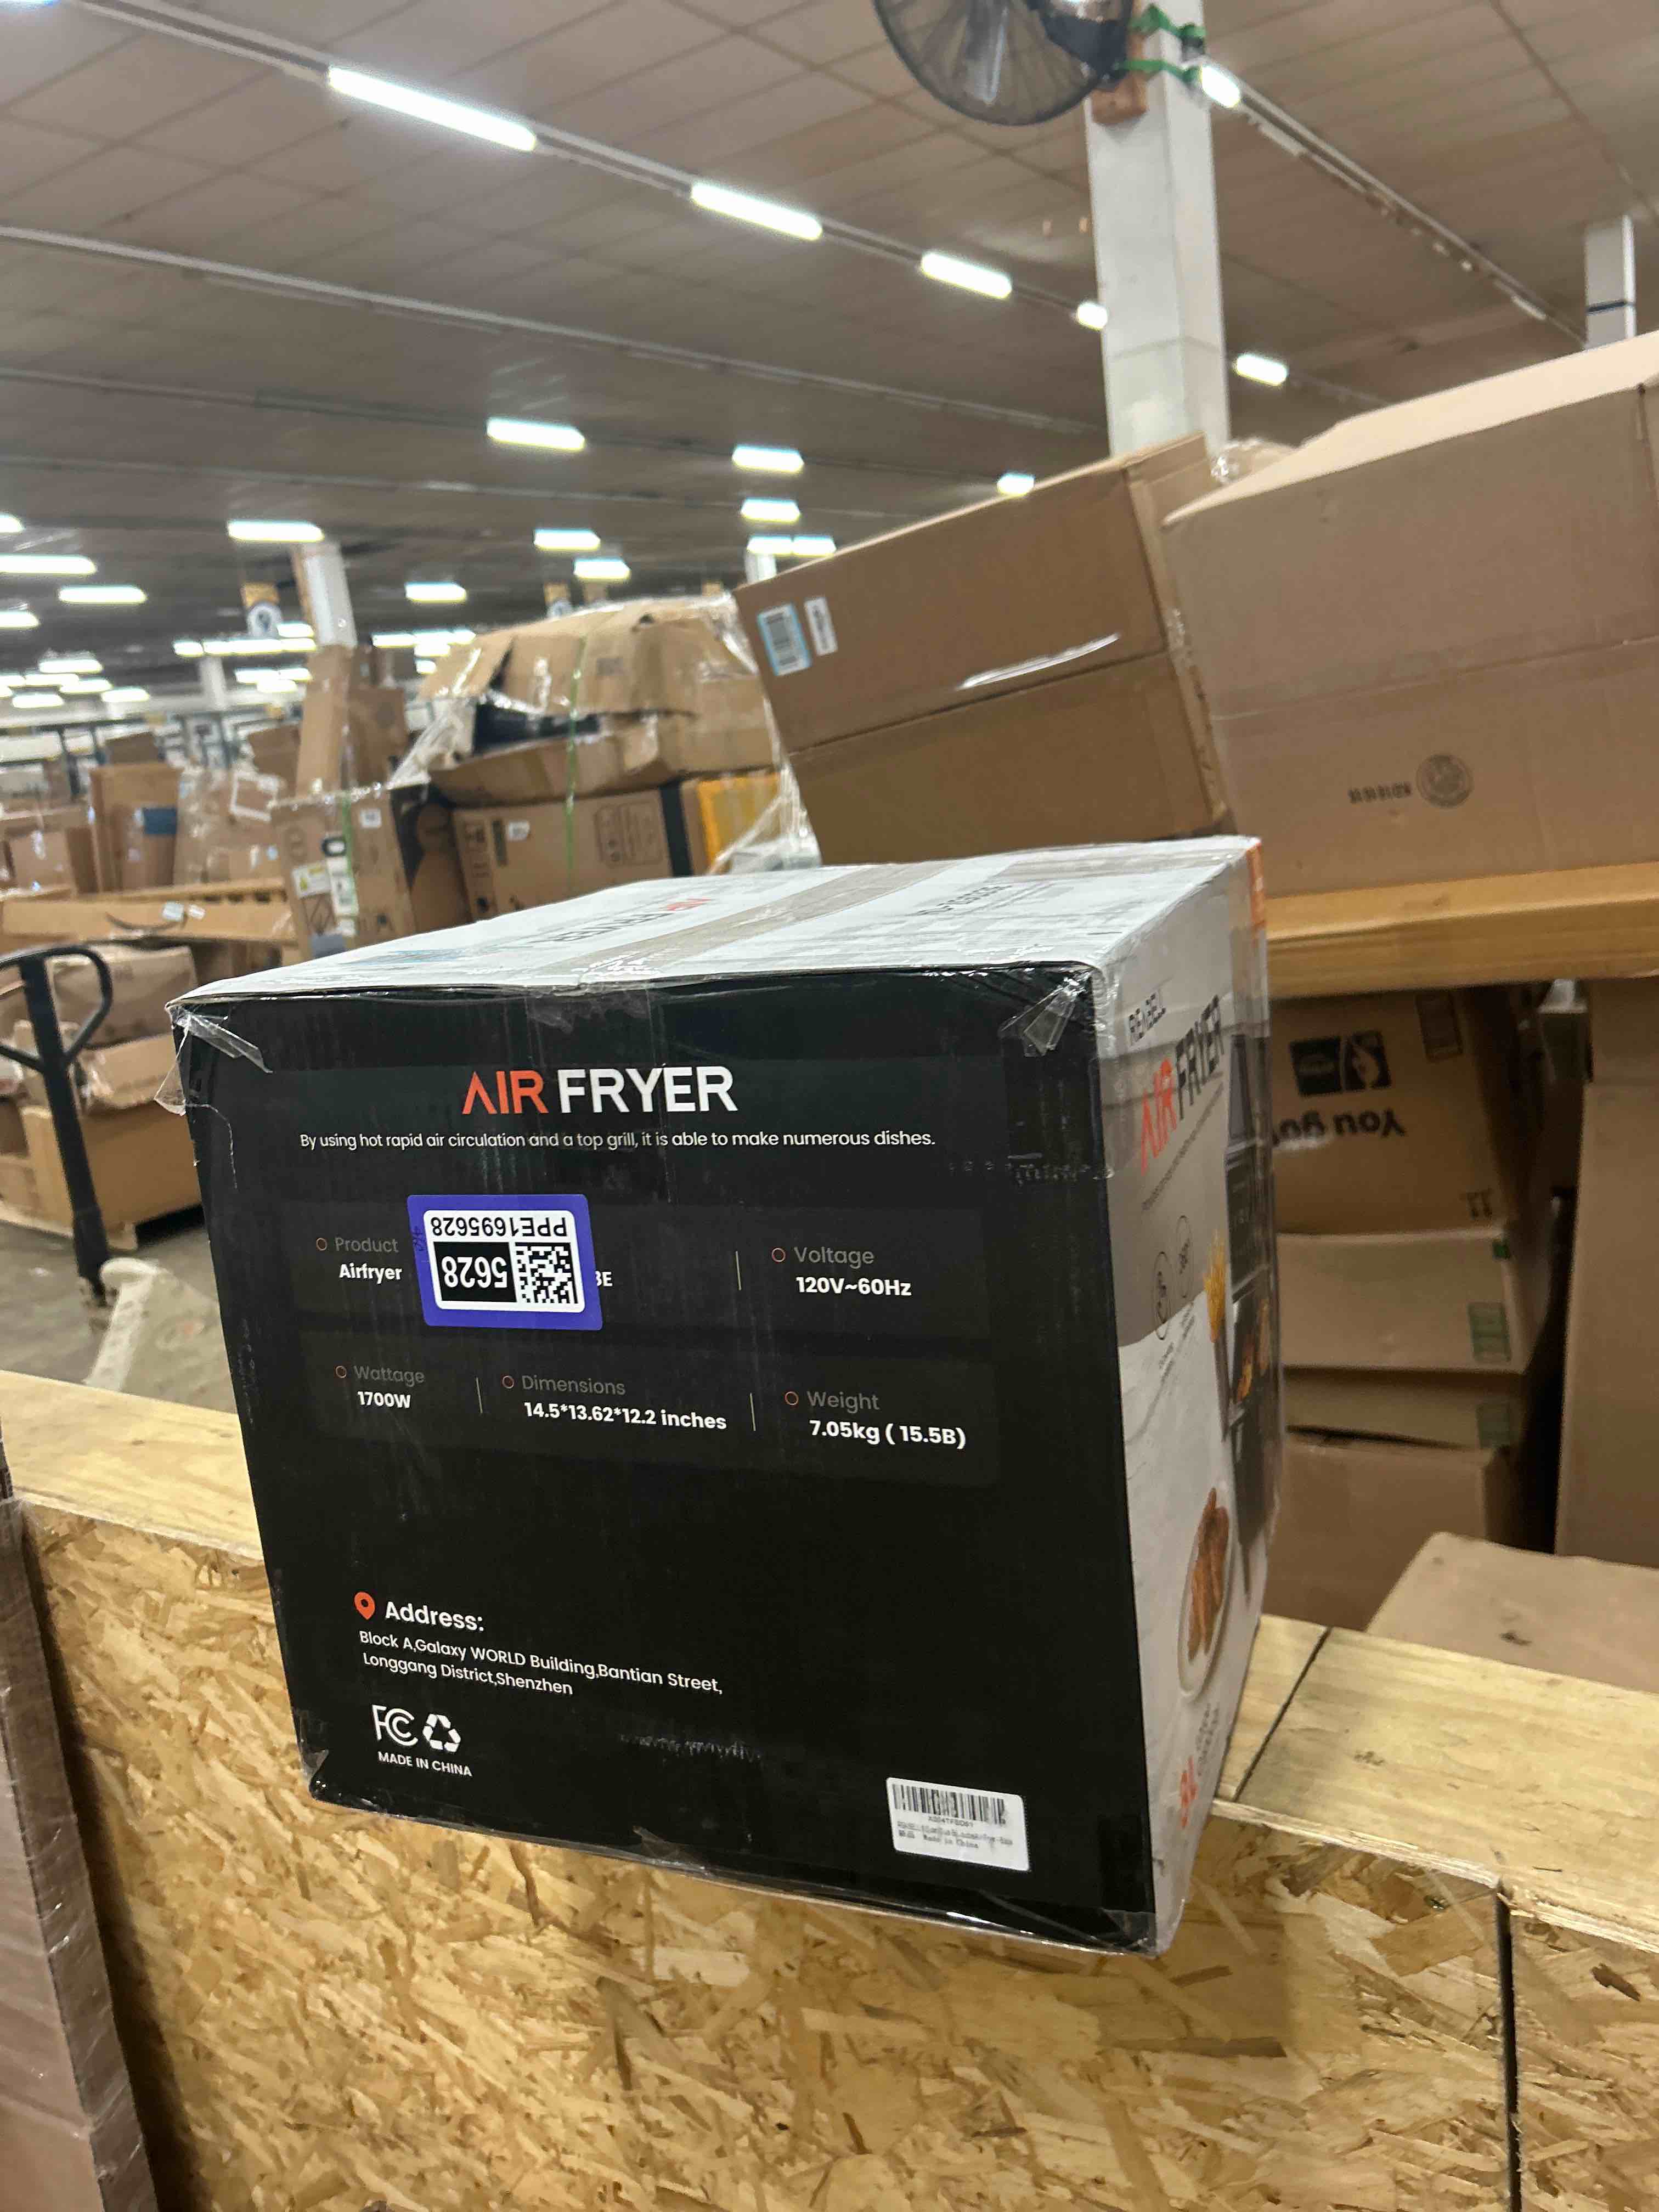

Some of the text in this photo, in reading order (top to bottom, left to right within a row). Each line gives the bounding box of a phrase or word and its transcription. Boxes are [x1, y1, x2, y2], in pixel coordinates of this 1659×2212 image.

[462, 1066, 738, 1114] AIR FRYER
[300, 1130, 935, 1150] By using hot rapid air circulation and a top grill, it is able to make numerous dishes.
[431, 1217, 567, 1237] PPE1695628
[335, 1238, 399, 1254] Product
[794, 1246, 874, 1270] Voltage
[339, 1263, 402, 1284] Airfryer
[441, 1256, 507, 1288] 5628
[796, 1277, 912, 1296] 120V~60Hz
[354, 1365, 426, 1388] Wattage
[522, 1375, 626, 1395] Dimensions
[358, 1391, 411, 1408] 1700W
[807, 1391, 879, 1414] Weight
[661, 1409, 727, 1430] inches
[809, 1420, 881, 1445] 7.05kg
[385, 1601, 484, 1632] Address:
[359, 1630, 399, 1647] Block
[403, 1637, 466, 1661] A,Galaxy
[470, 1646, 526, 1666] WORLD
[667, 1673, 723, 1695] Street,
[363, 1652, 573, 1695] Longgang District,Shenzhen
[377, 1751, 473, 1777] MADE IN CHINA
